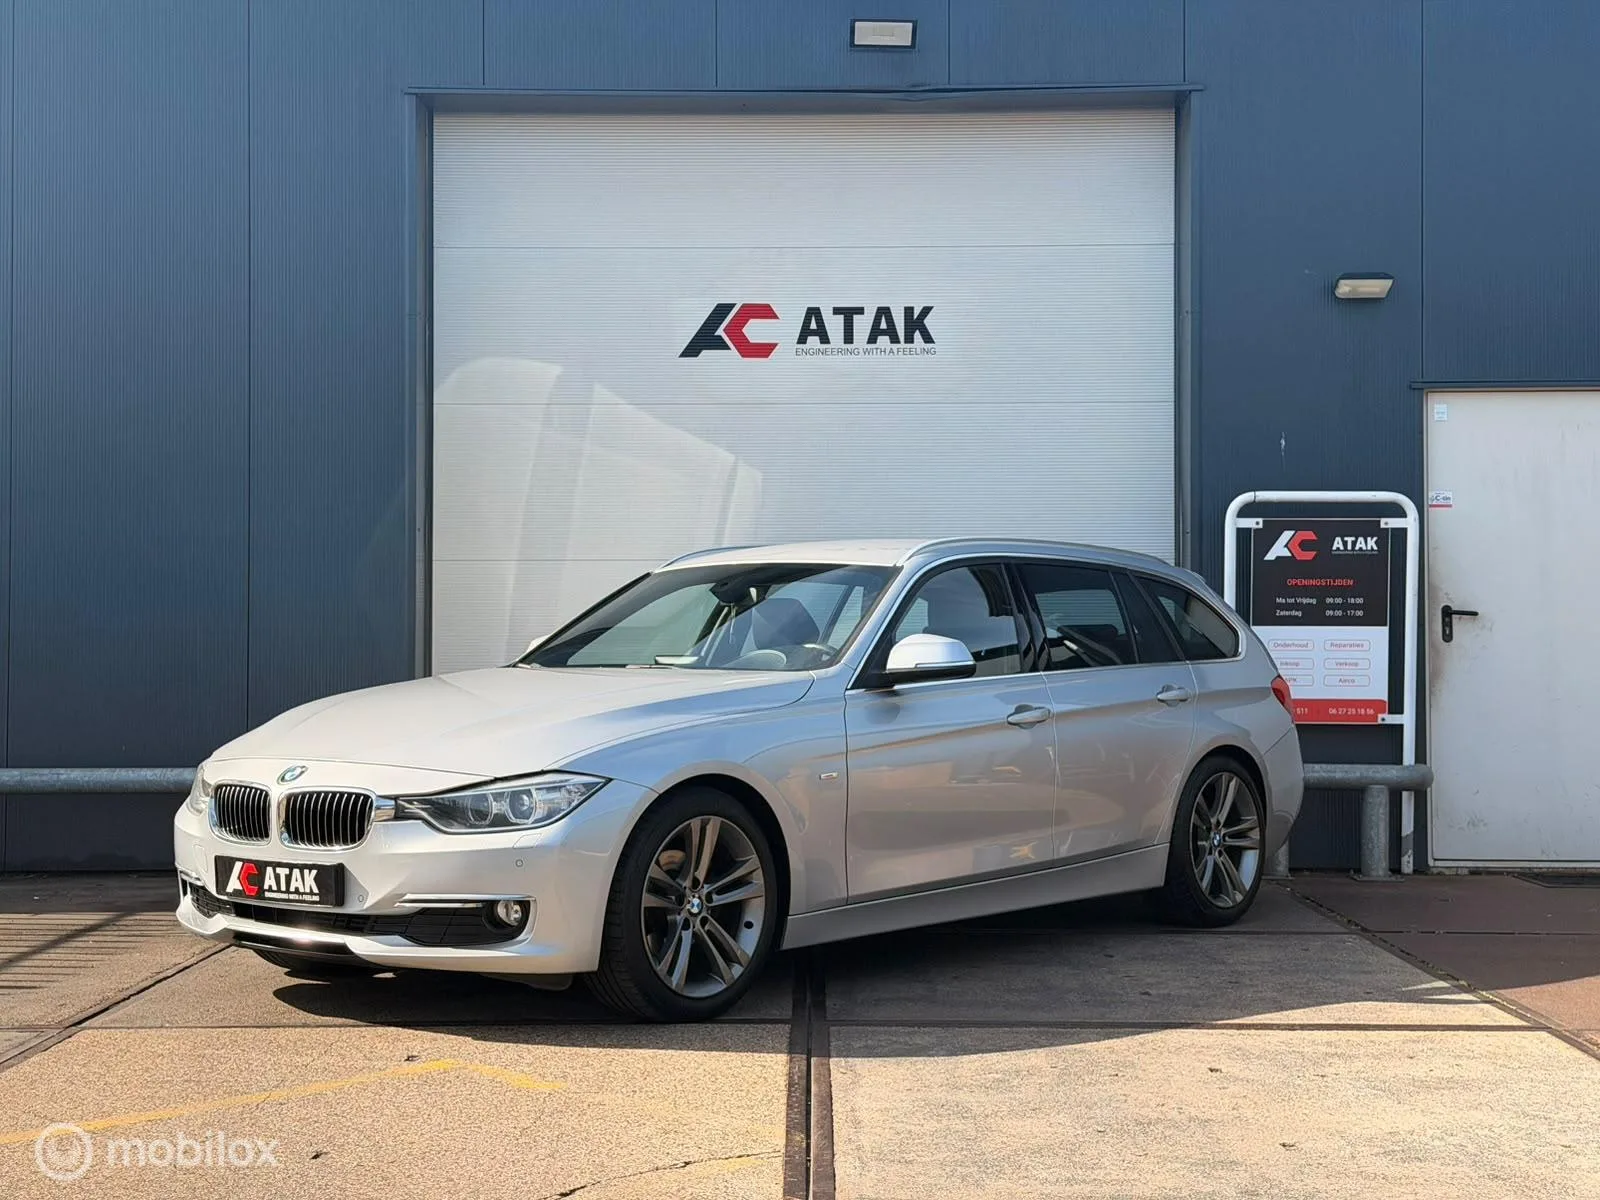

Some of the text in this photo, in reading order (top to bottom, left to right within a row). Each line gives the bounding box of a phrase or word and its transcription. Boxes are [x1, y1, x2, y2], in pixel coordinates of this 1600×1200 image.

[796, 306, 936, 345] ATAK
[795, 347, 937, 356] ENGINEERING WITH A FEELING
[1332, 536, 1378, 550] ATAK
[1286, 578, 1354, 586] OPENINGSTIJDEN
[1296, 597, 1317, 605] Vrijdag
[1276, 609, 1302, 617] Zaterdag
[1330, 642, 1365, 650] Reparaties
[264, 866, 319, 893] ATAK
